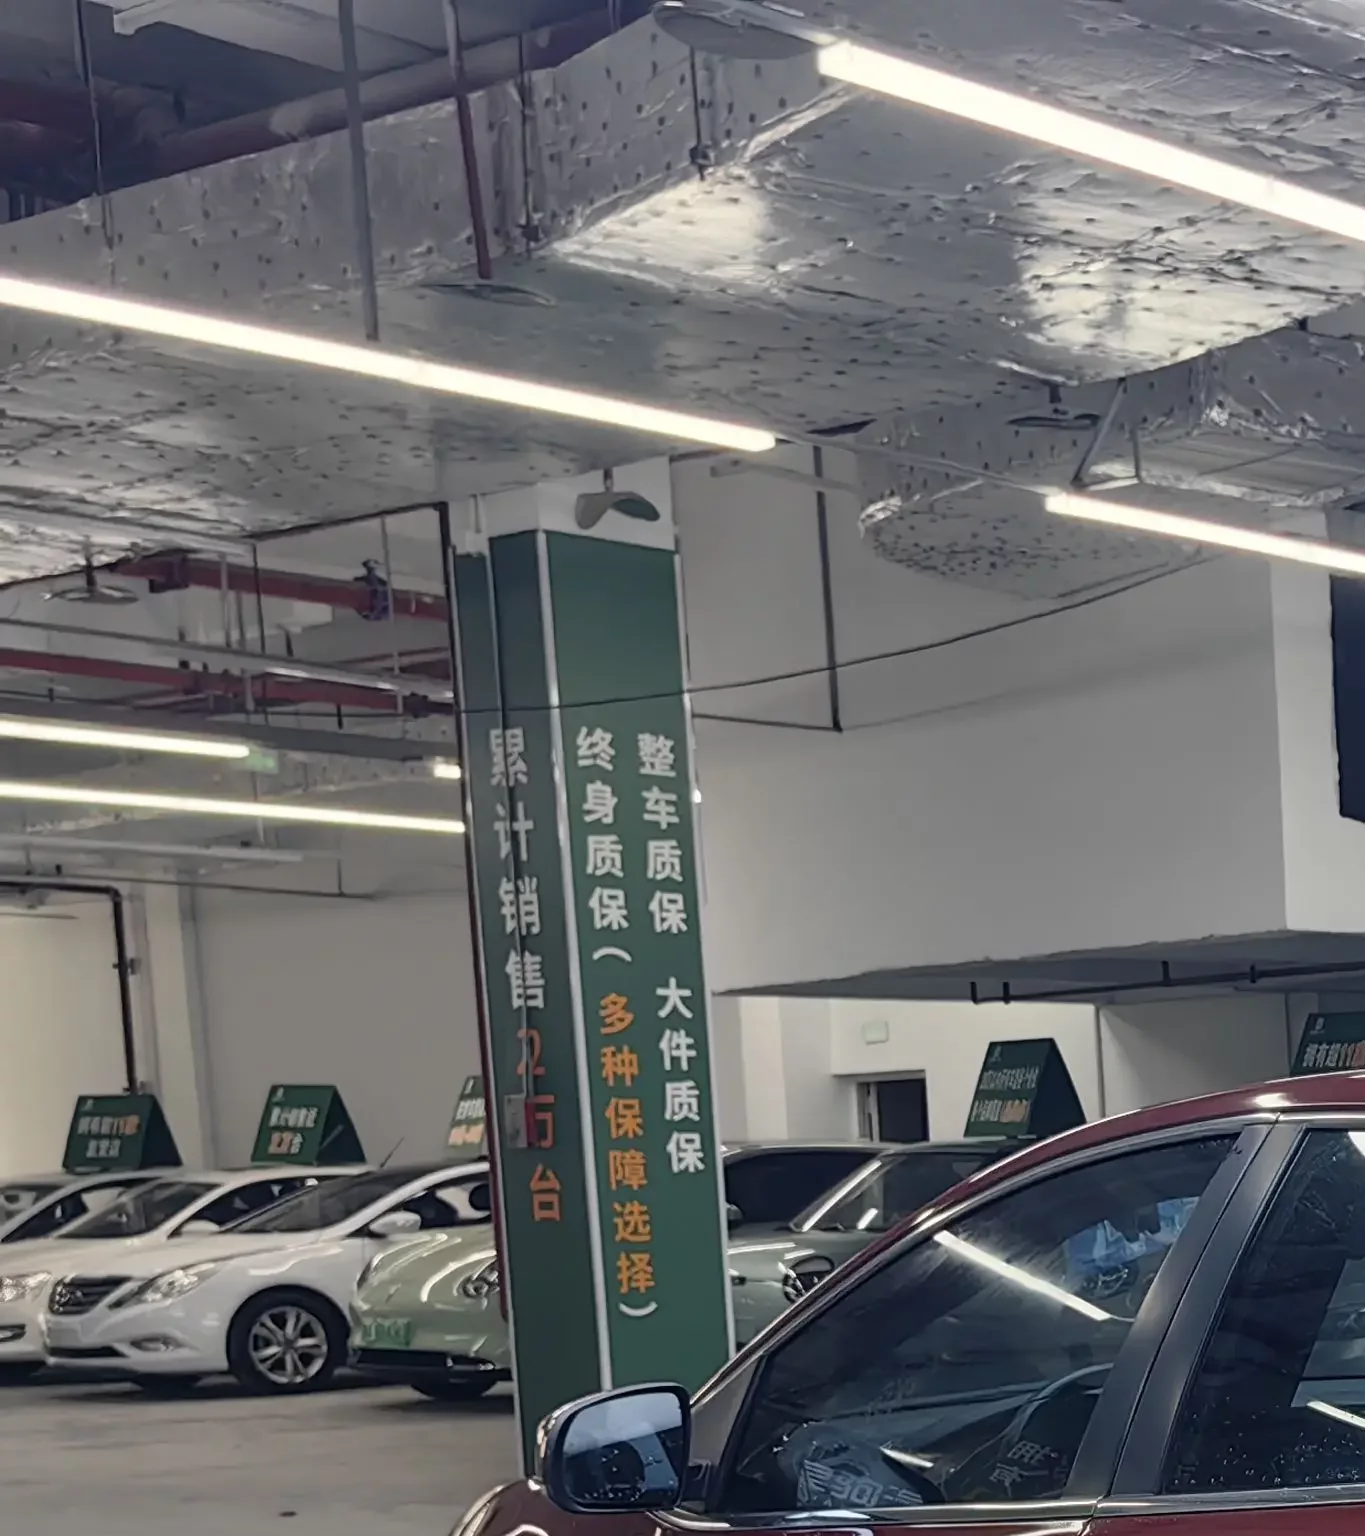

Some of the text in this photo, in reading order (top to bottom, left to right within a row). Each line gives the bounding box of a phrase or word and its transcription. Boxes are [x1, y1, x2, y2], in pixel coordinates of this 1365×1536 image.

[636, 732, 706, 1174] 整车质保 大件质保
